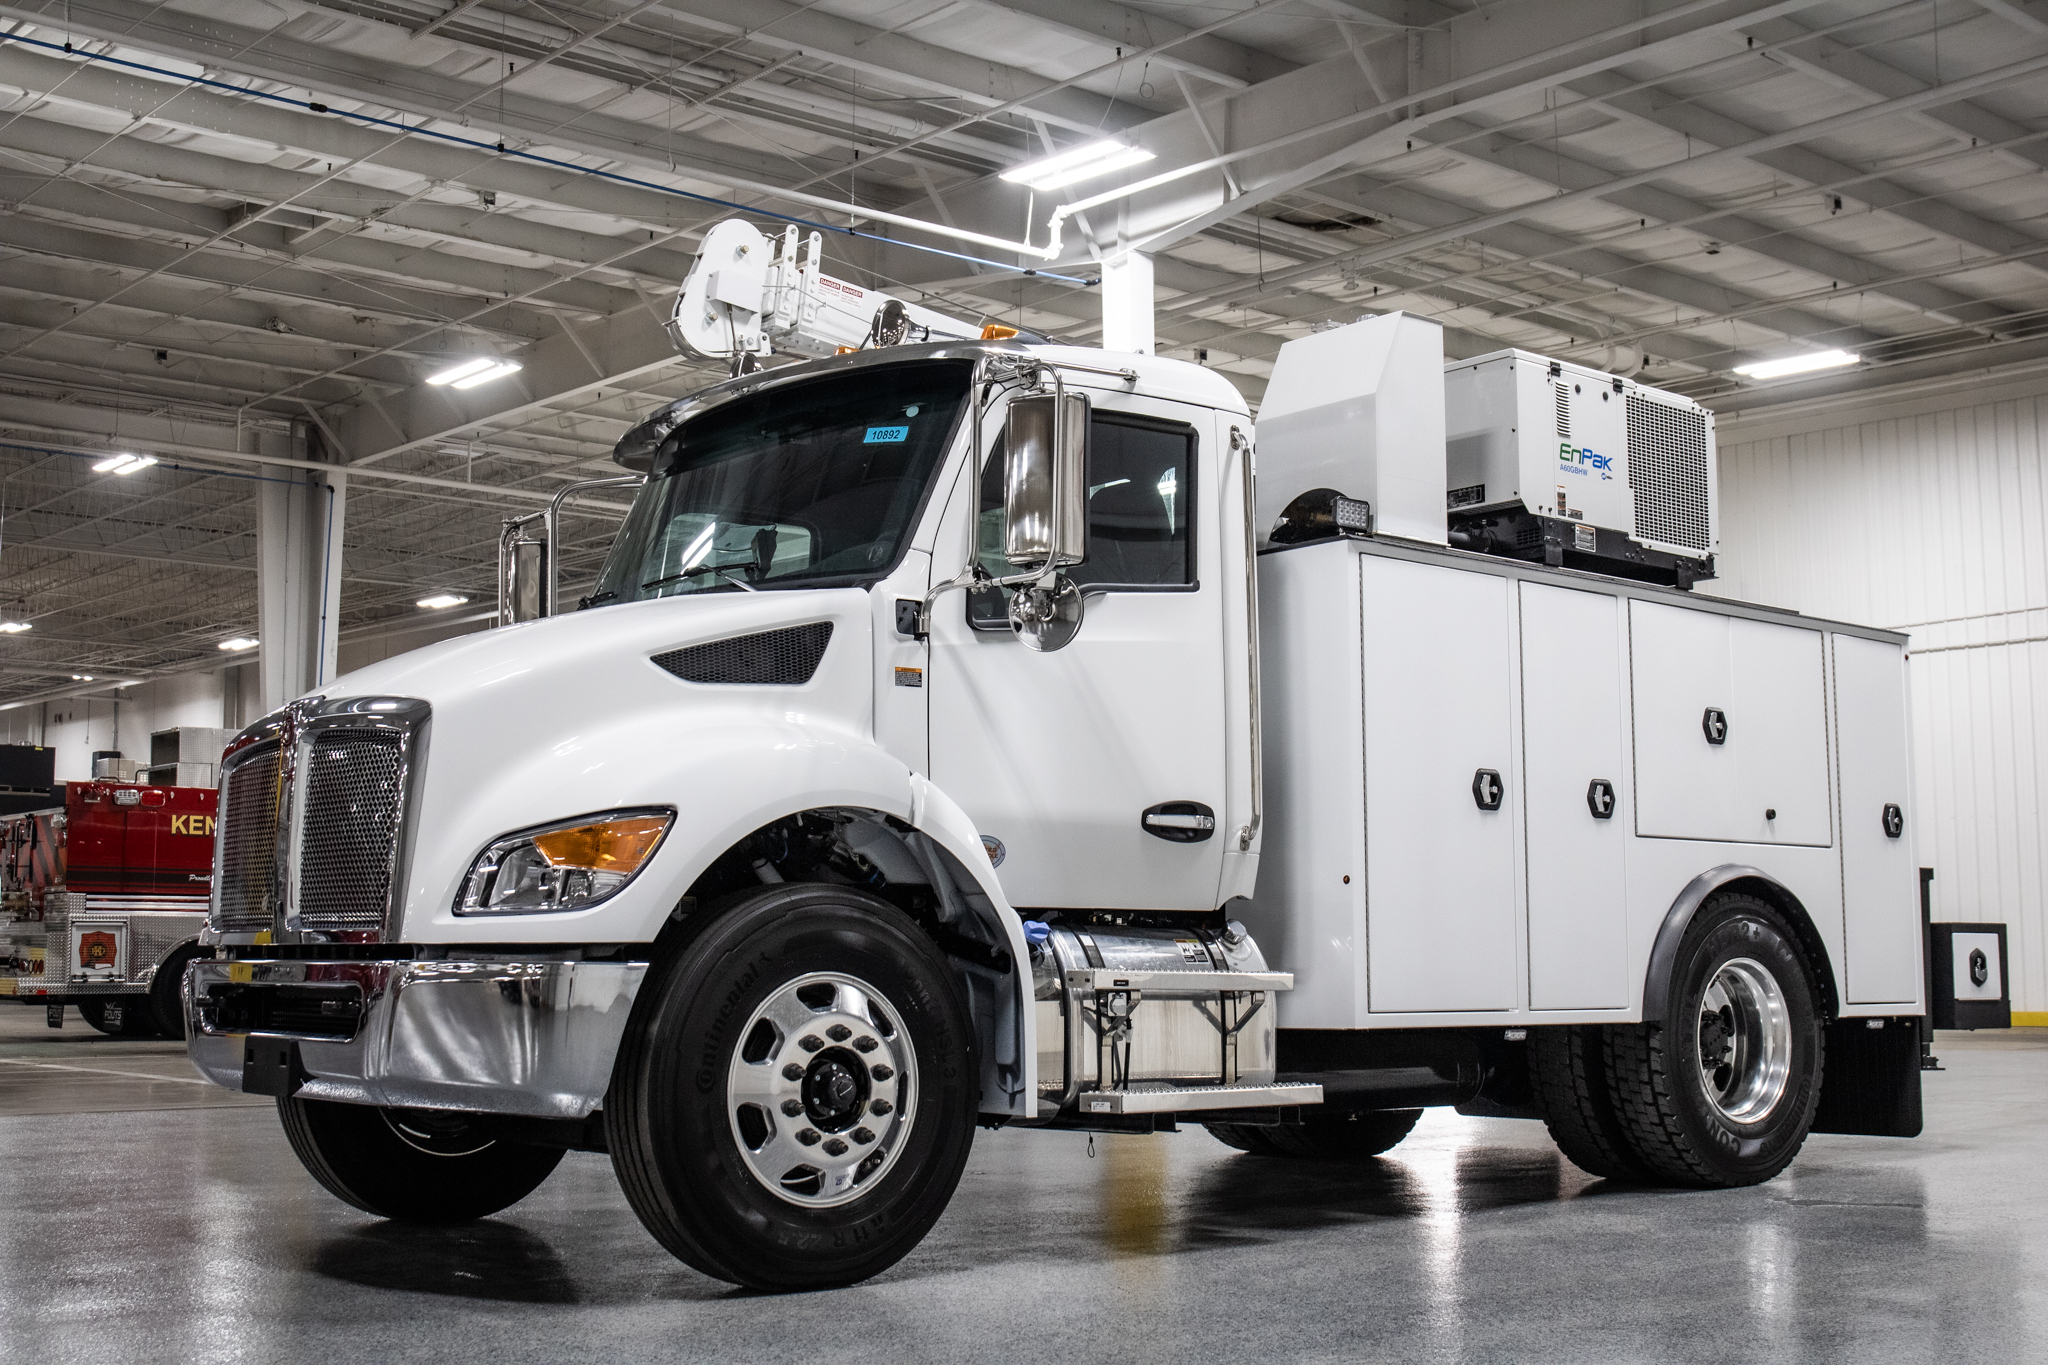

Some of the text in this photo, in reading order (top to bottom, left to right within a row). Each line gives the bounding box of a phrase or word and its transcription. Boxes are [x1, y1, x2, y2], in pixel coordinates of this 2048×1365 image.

[820, 279, 840, 290] DANGER
[842, 287, 862, 298] DANGER
[872, 430, 901, 440] 10892
[1560, 443, 1613, 472] EnPak
[1560, 463, 1588, 477] A60GBHW
[171, 814, 215, 836] KEN
[104, 1010, 122, 1020] FOUTS
[696, 962, 760, 1094] Continental
